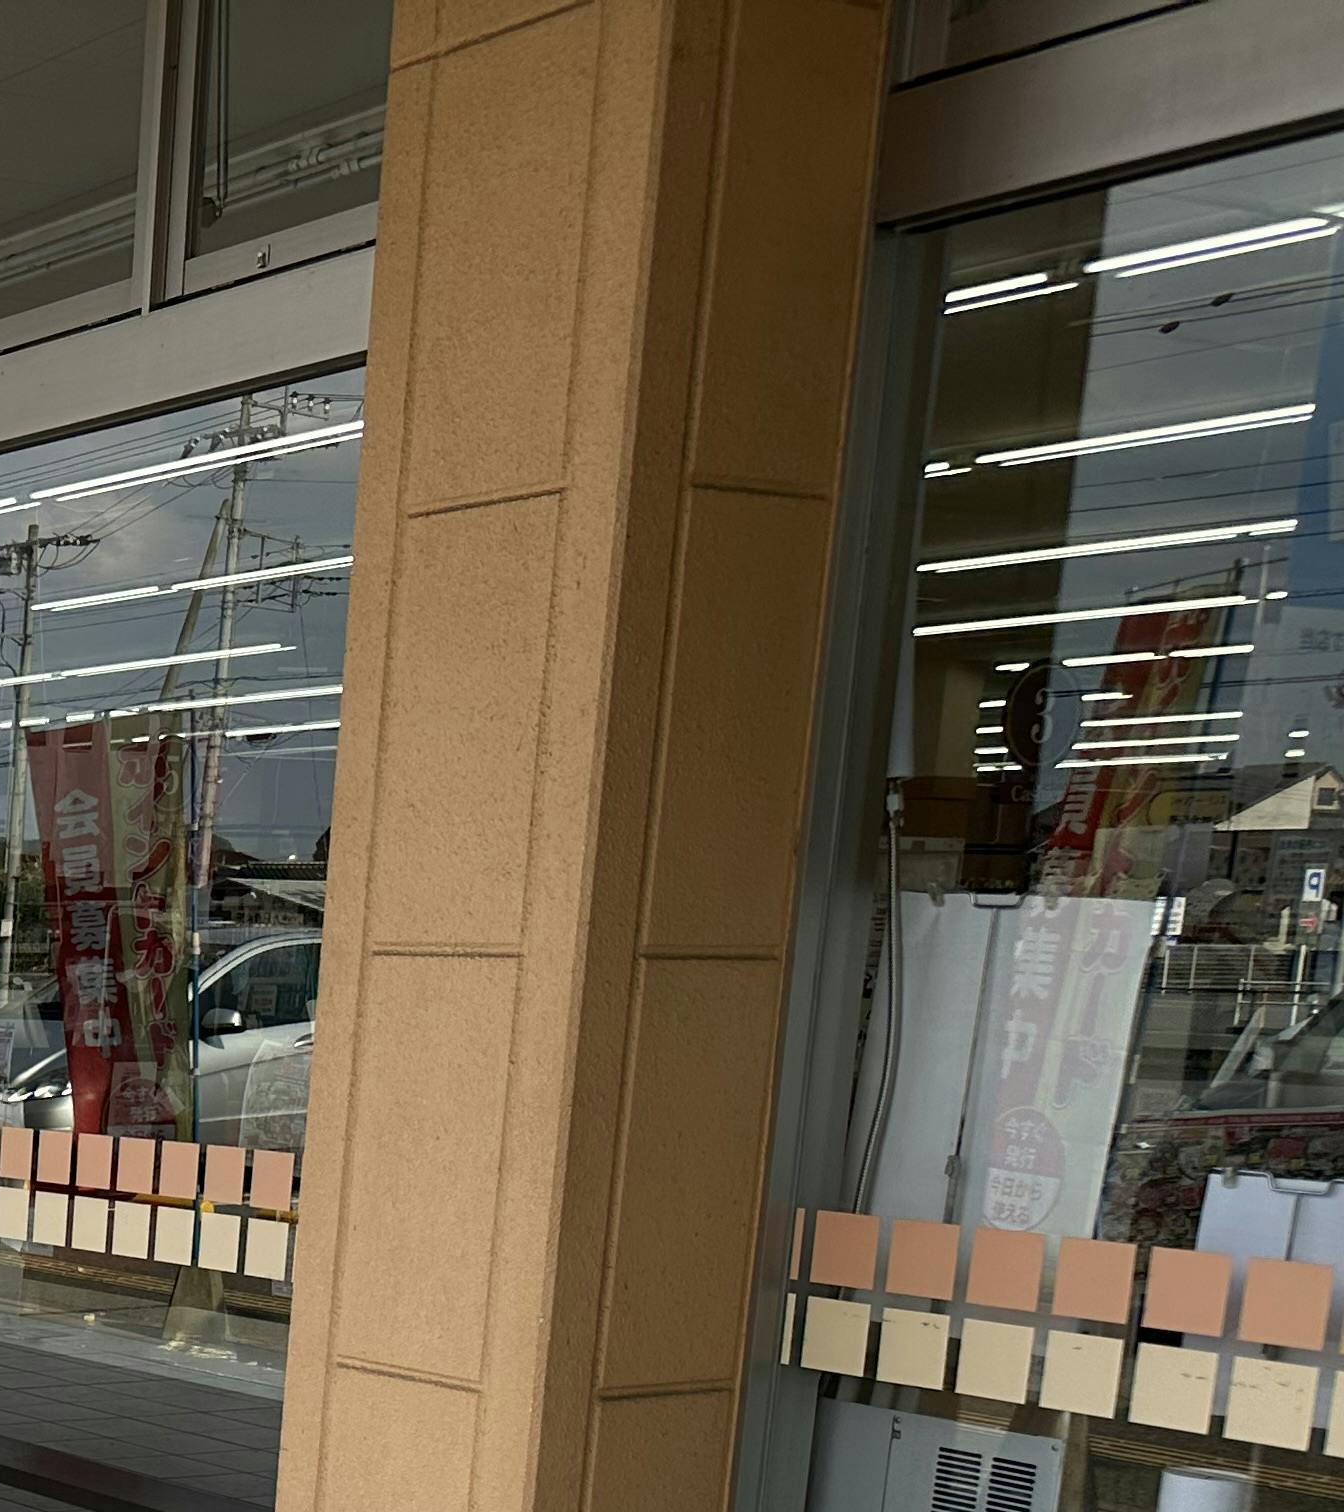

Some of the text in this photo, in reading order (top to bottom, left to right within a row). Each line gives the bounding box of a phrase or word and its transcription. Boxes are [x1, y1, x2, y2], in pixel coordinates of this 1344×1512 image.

[54, 788, 123, 1060] 会員募集中
